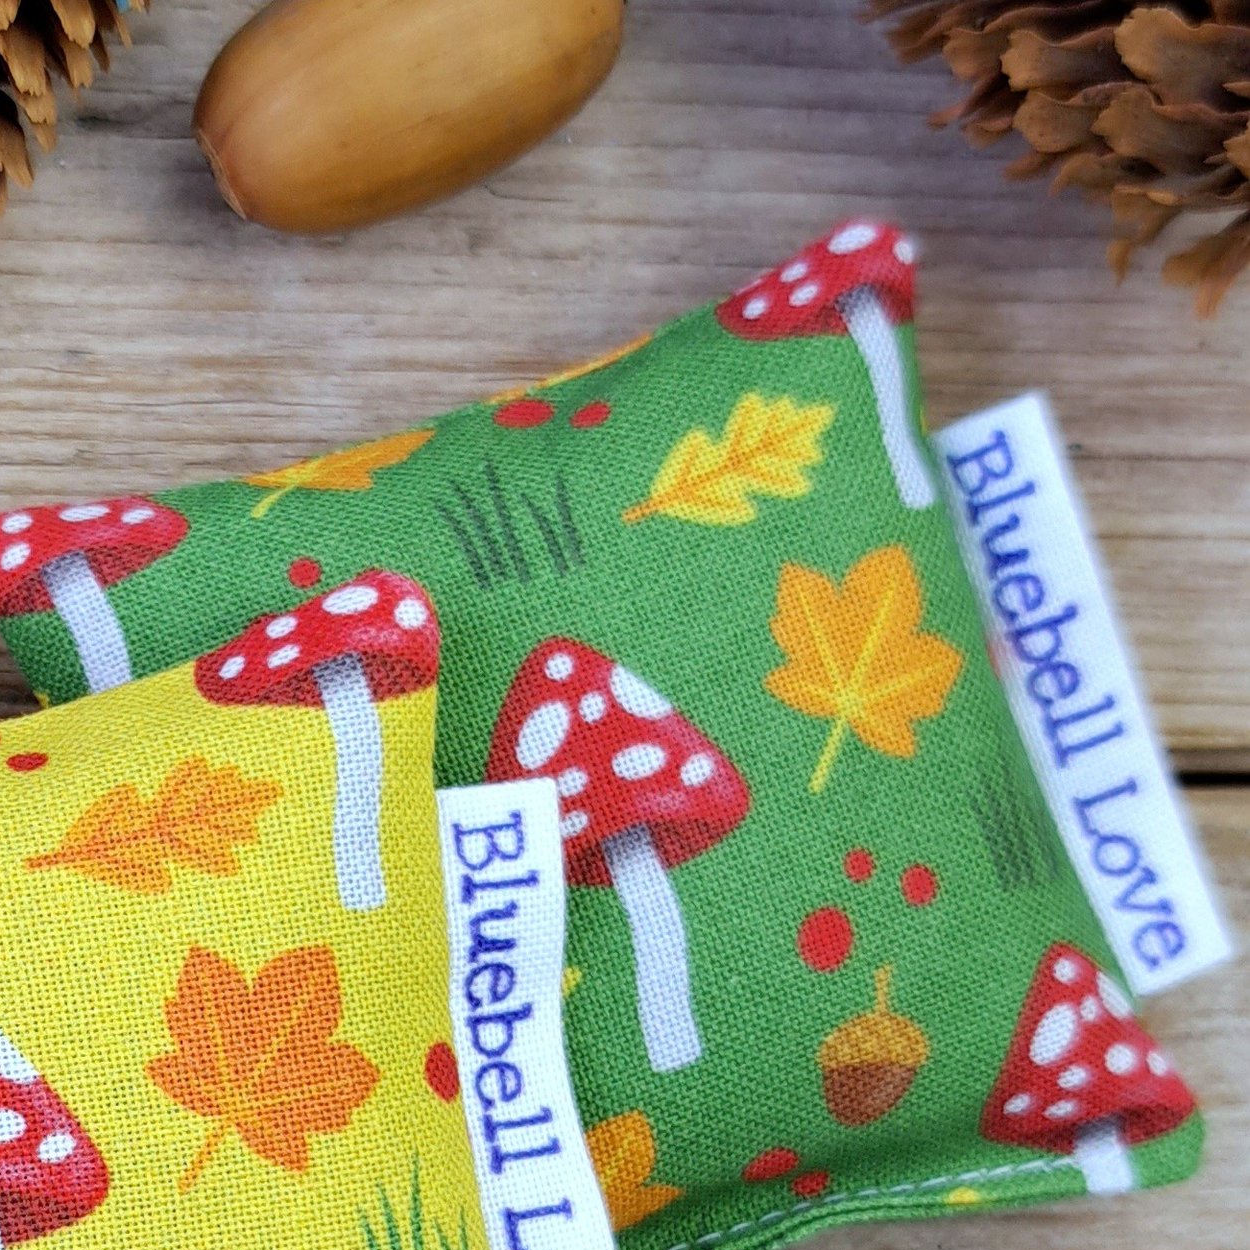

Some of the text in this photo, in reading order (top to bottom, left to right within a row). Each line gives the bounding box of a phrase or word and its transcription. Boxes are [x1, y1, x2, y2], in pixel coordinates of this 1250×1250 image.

[947, 430, 1188, 969] Bluebell Love
[452, 810, 562, 1176] Bluebell
